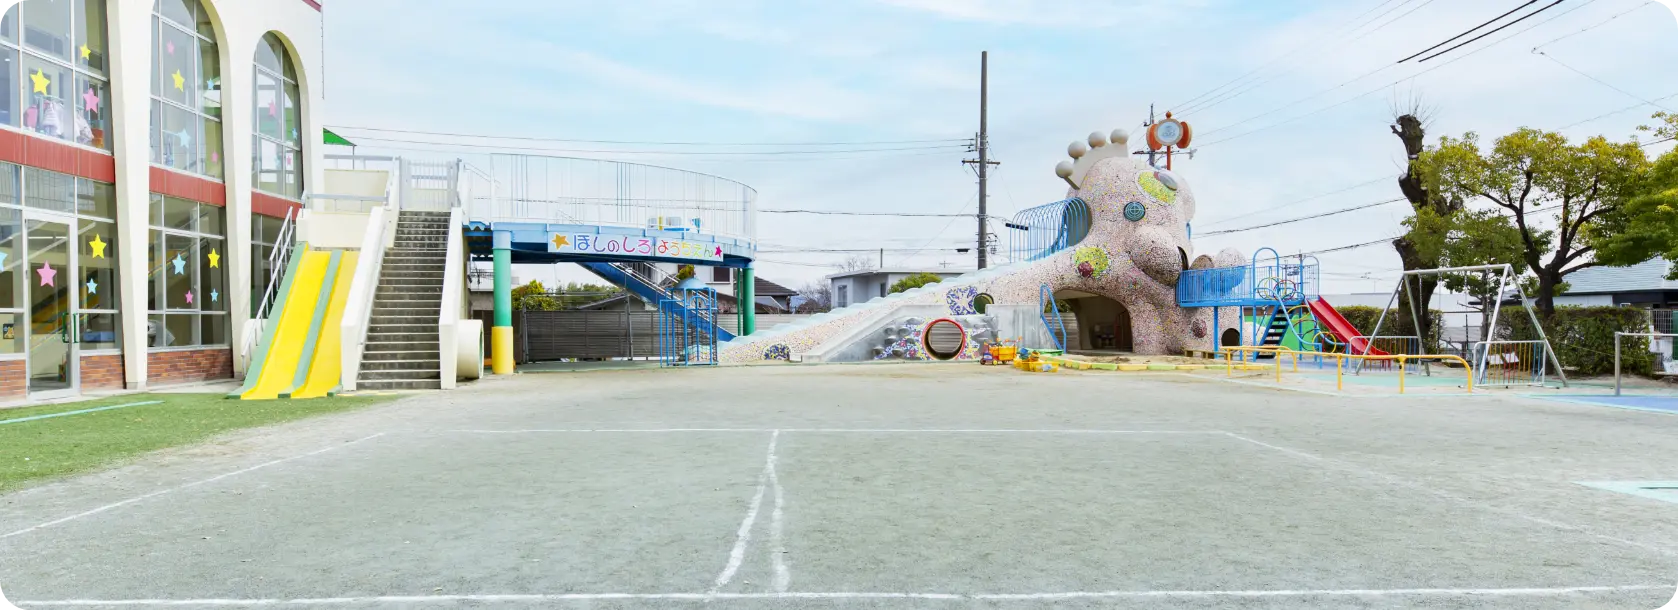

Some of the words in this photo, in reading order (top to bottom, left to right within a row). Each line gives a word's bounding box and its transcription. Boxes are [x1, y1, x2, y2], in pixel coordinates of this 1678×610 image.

[573, 234, 652, 254] ほしのしろ
[657, 239, 713, 258] ようちえん
